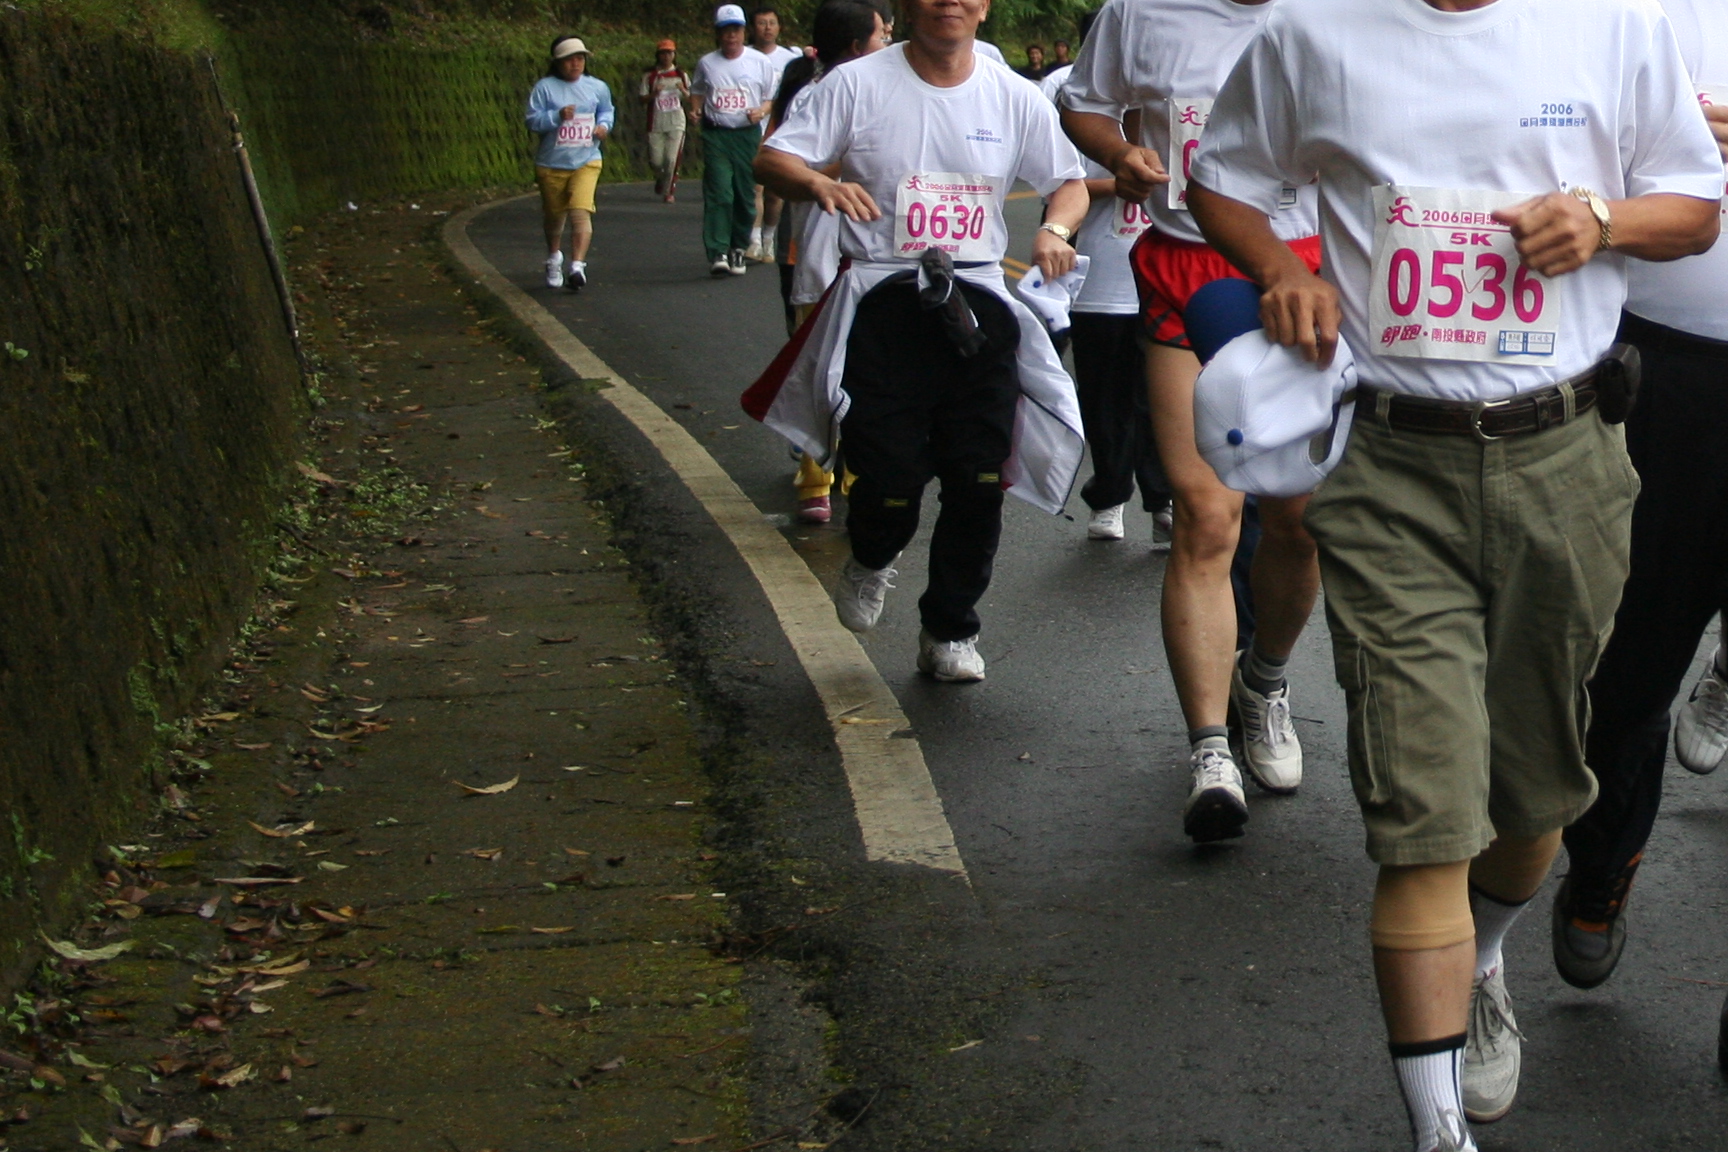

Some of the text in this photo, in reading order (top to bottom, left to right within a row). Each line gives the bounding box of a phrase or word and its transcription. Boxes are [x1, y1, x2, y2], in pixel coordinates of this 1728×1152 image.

[1541, 103, 1573, 115] 2006
[940, 194, 962, 202] 5K
[907, 202, 984, 240] 0630
[1451, 232, 1492, 247] 5K
[1388, 248, 1544, 323] 0536
